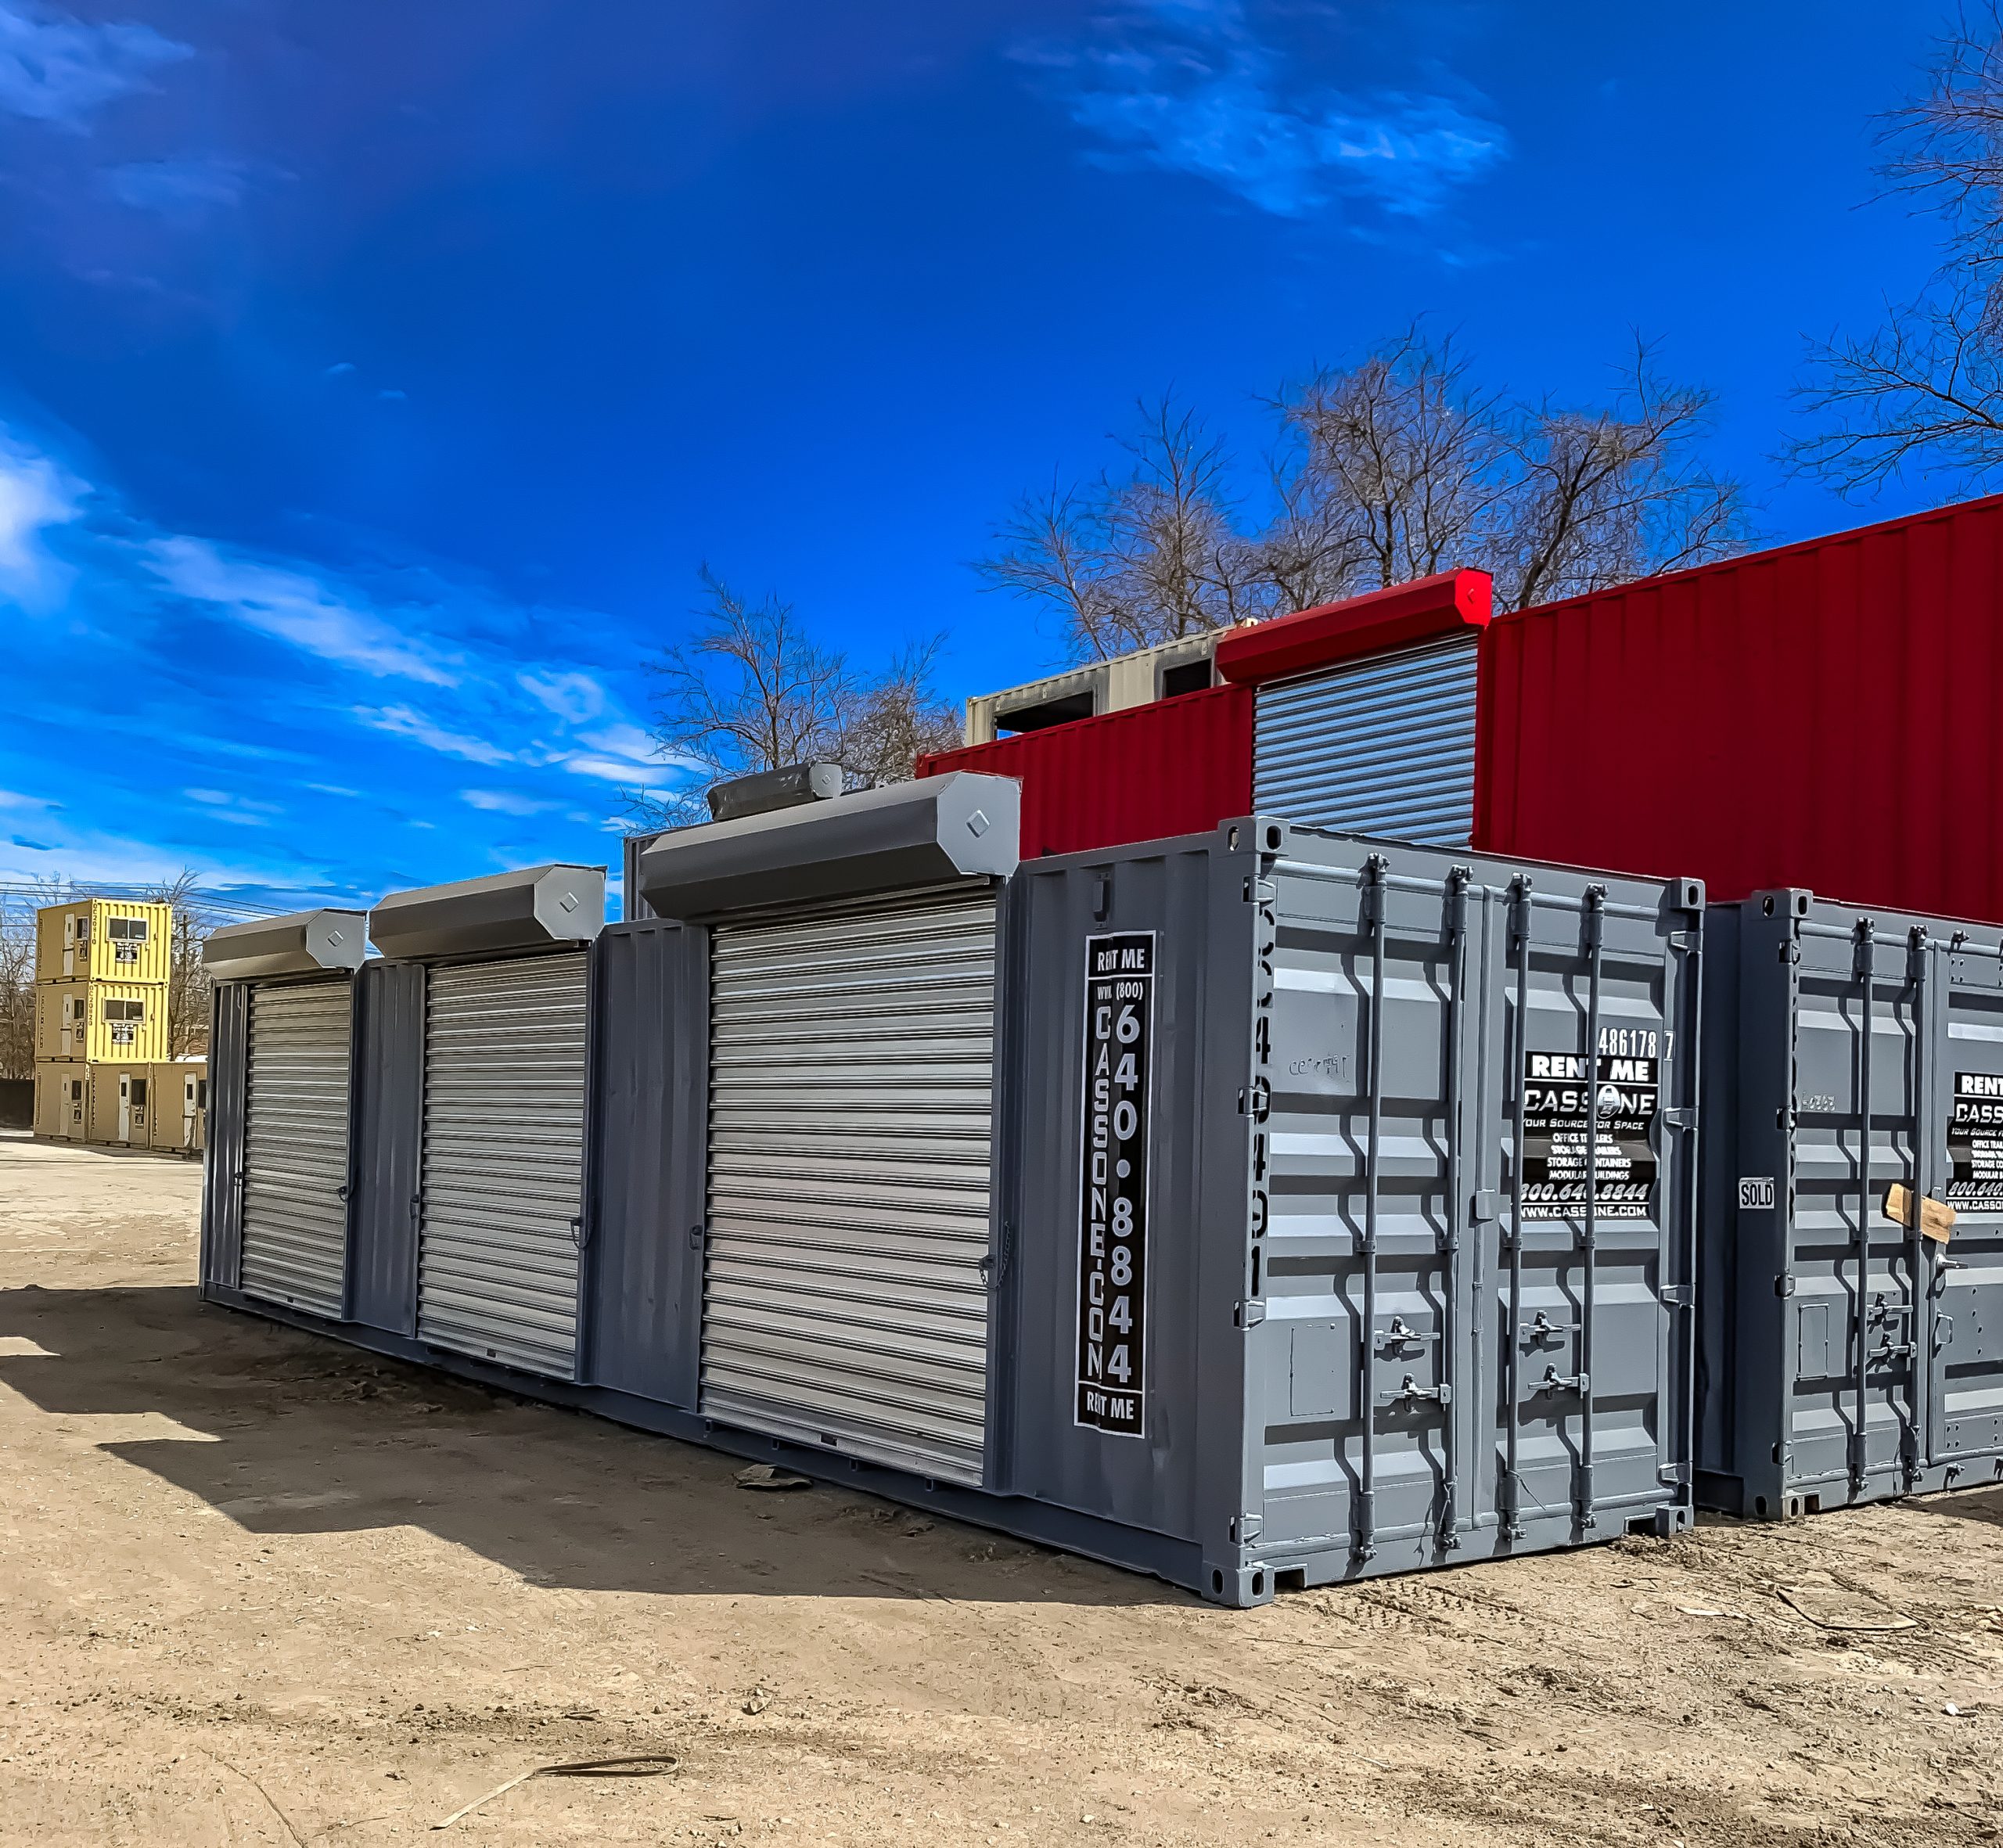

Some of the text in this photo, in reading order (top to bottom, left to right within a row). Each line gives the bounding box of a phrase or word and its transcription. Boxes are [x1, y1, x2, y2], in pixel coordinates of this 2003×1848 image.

[1121, 948, 1145, 969] ME
[1116, 981, 1143, 1001] (800)
[1598, 1027, 1674, 1059] 486178 7
[1609, 1059, 1649, 1082] ME
[1552, 1132, 1613, 1144] OFFICE TLERS
[1547, 1157, 1631, 1168] STORAGE NTAINERS
[1595, 1170, 1630, 1181] UILDINGS
[1741, 1184, 1773, 1206] SOLD
[1521, 1206, 1646, 1217] WWW.CASSNE.COM
[1110, 1397, 1135, 1419] ME
